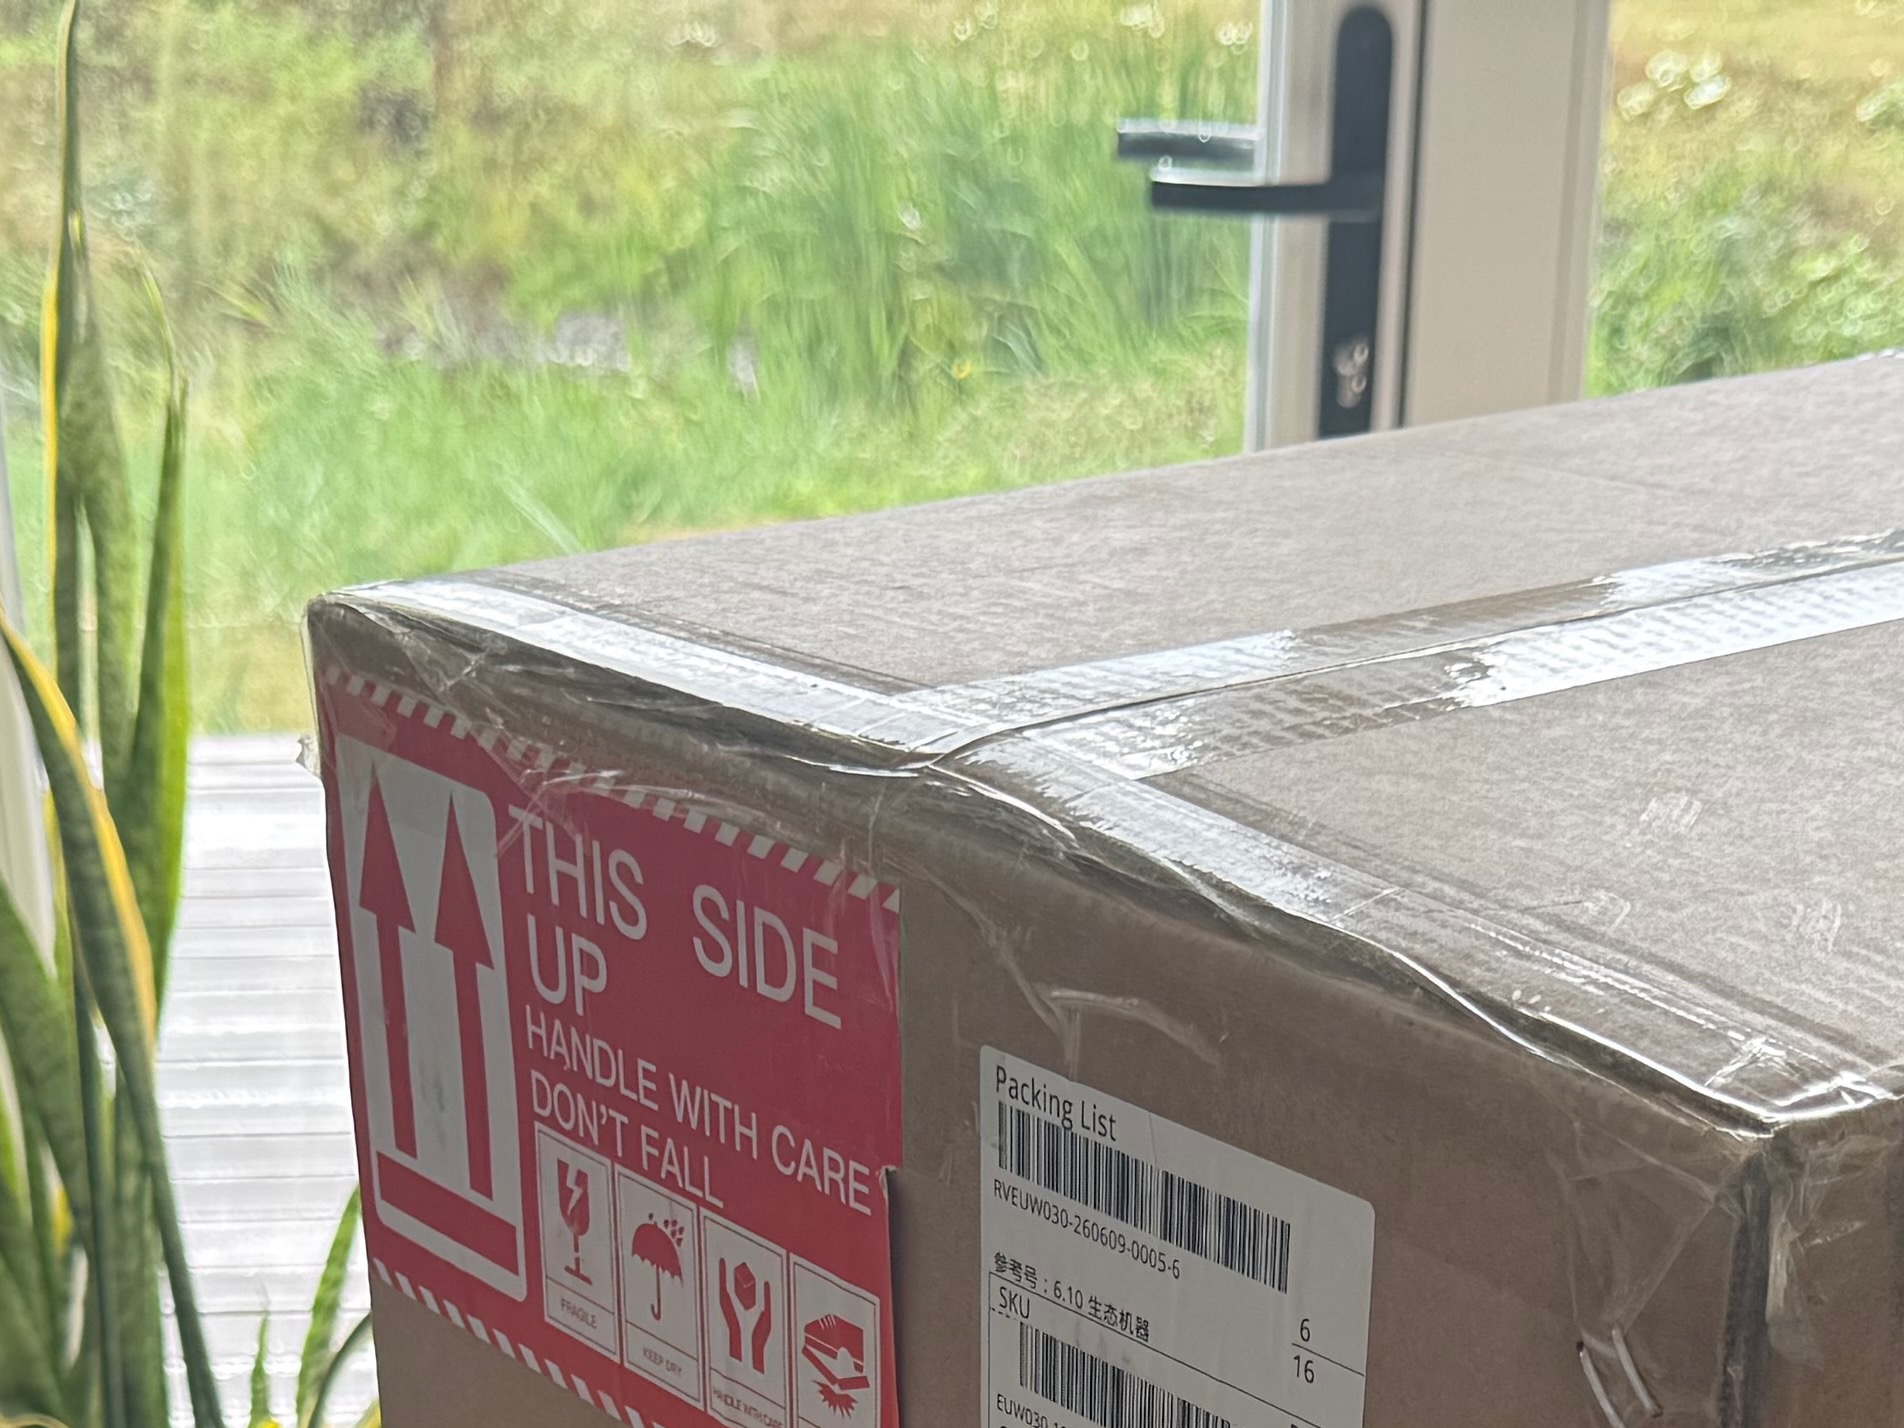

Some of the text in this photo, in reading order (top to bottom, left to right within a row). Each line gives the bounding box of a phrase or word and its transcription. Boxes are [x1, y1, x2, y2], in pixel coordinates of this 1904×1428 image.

[508, 806, 842, 1029] THIS SIDE
[527, 913, 607, 1016] UP
[525, 1004, 872, 1216] HANDLE WITH CARE
[996, 1065, 1117, 1142] Packing List
[641, 1123, 723, 1208] FALL
[993, 1179, 1181, 1280] RVEUW030-260609-0005-6
[560, 1296, 597, 1329] FRAGILE
[999, 1287, 1031, 1319] SKU
[1053, 1280, 1084, 1310] 6.10
[1088, 1297, 1150, 1343] 生态机器
[1299, 1318, 1311, 1344] 6
[1292, 1354, 1315, 1385] 16
